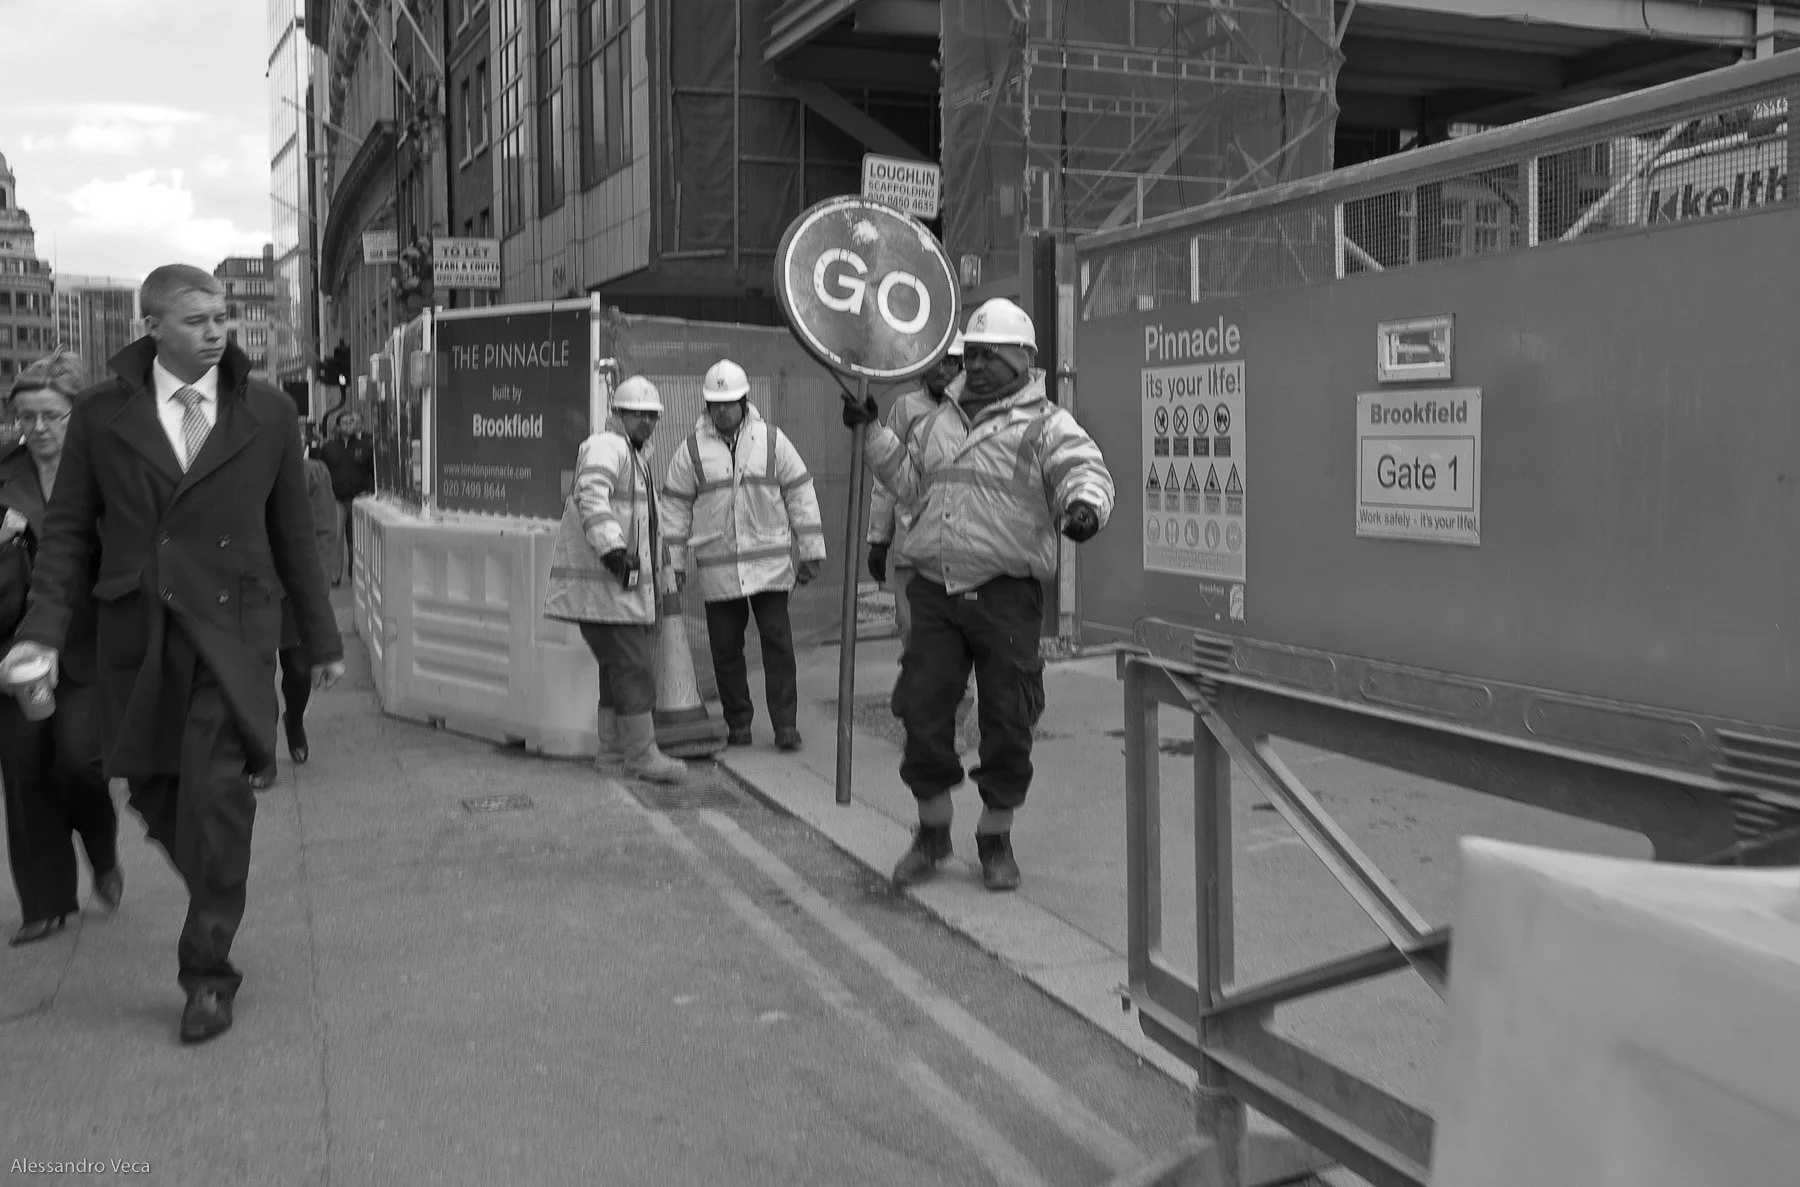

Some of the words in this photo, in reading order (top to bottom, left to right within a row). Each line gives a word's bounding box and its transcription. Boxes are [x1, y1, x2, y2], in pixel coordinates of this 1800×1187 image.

[870, 162, 935, 186] LOUGHLIN
[868, 179, 935, 200] SCAFFOLDING
[442, 246, 460, 258] TO
[465, 246, 490, 258] LET
[812, 247, 931, 335] GO
[1145, 315, 1241, 363] Pinnacle
[452, 344, 479, 370] THE
[485, 339, 570, 369] PINNACLE
[492, 384, 510, 401] built
[512, 384, 523, 404] by
[1167, 374, 1203, 404] your
[1370, 401, 1468, 425] Brookfield
[472, 413, 543, 439] Brookfield
[1377, 453, 1437, 491] Gate
[1447, 455, 1458, 491] 1
[443, 479, 459, 497] 020
[1359, 508, 1382, 526] Work
[1384, 510, 1411, 529] safely
[1420, 512, 1434, 529] it's
[1434, 515, 1456, 531] your
